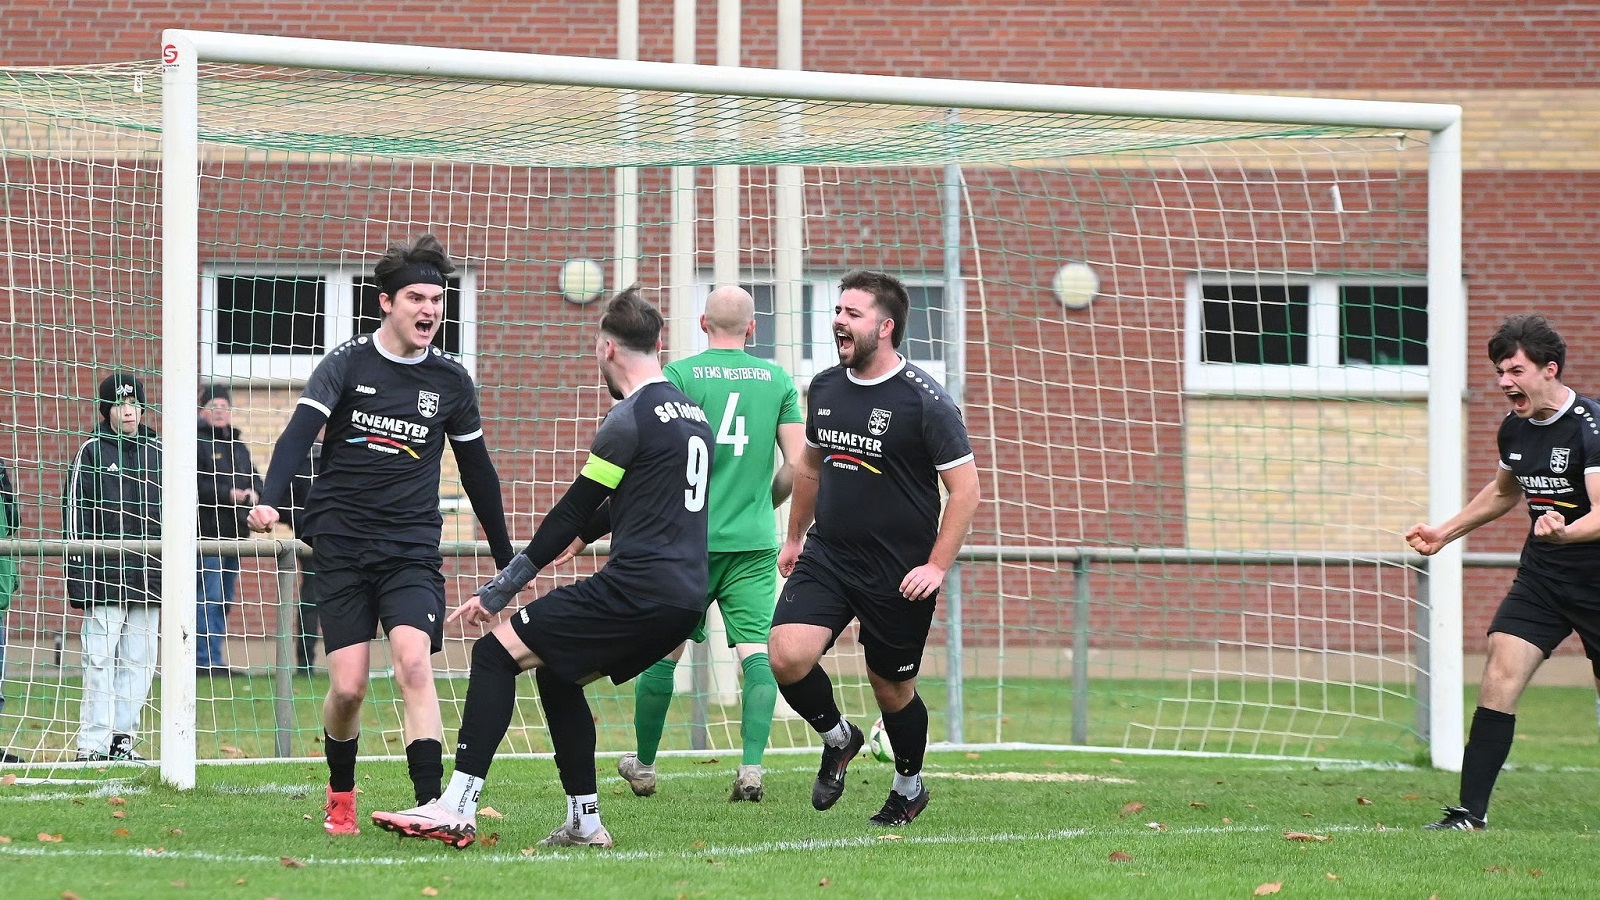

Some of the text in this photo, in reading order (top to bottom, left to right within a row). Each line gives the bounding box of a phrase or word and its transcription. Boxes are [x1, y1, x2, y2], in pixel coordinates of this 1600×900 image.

[692, 366, 772, 382] SV EMS WESTBEVERN
[355, 384, 377, 395] JAKO
[654, 401, 679, 424] SG
[817, 408, 831, 417] JAKO
[351, 409, 429, 439] KNEMEYER
[715, 392, 749, 457] 4
[817, 427, 882, 453] KNEMEYER
[684, 435, 709, 513] 9
[1515, 475, 1571, 489] NEMEYER
[897, 663, 914, 673] JAKO
